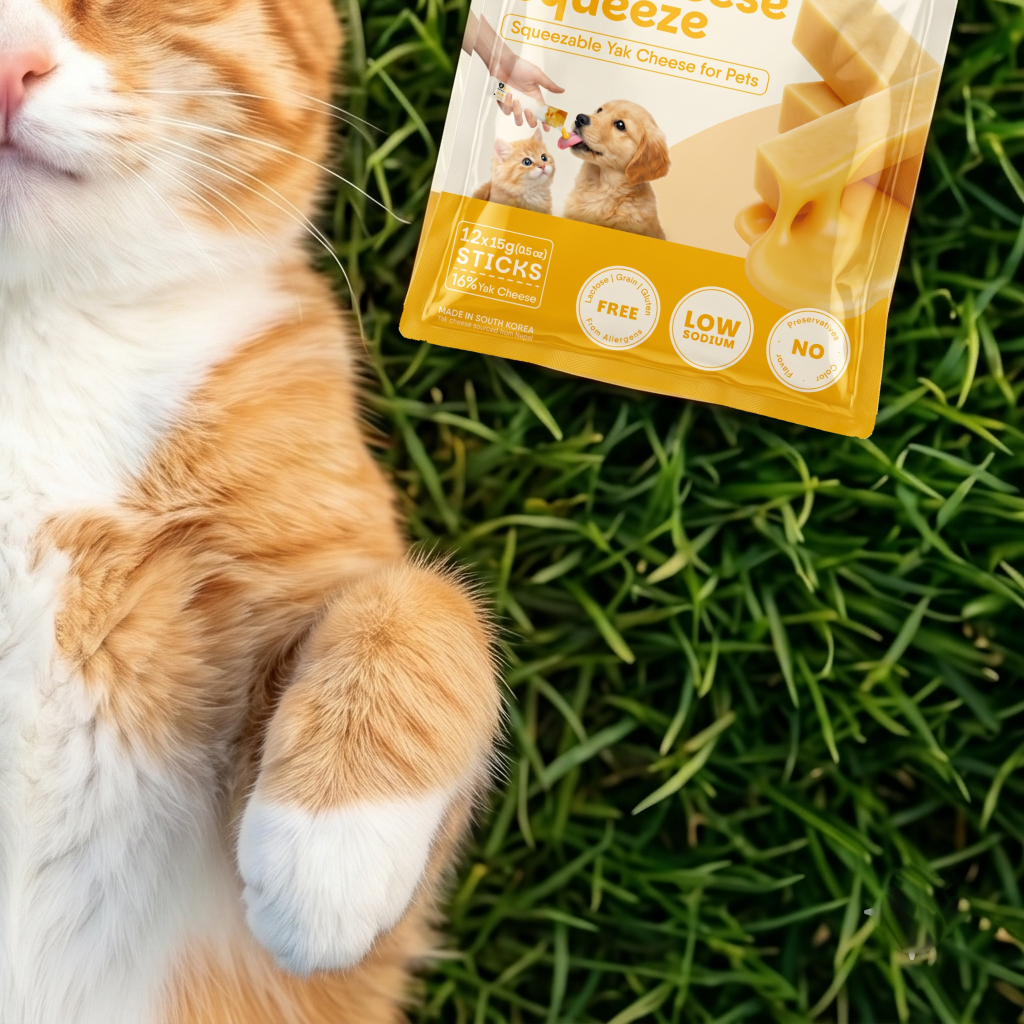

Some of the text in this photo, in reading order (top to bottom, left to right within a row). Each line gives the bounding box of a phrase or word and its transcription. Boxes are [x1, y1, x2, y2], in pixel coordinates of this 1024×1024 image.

[511, 20, 759, 87] Squeezable Yak Cheese for Pets
[456, 247, 542, 281] STICKS
[497, 287, 537, 303] Cheese
[584, 273, 656, 316] Lactose Grain Gluten
[438, 306, 534, 334] MADE IN SOUTH KOREA
[596, 300, 639, 320] FREE
[683, 310, 741, 338] LOW
[583, 318, 643, 349] From Allergens
[682, 330, 735, 349] SODIUM
[787, 312, 842, 341] Preservatives
[791, 339, 825, 360] NO
[771, 354, 793, 379] Flavor
[816, 364, 837, 385] Color
